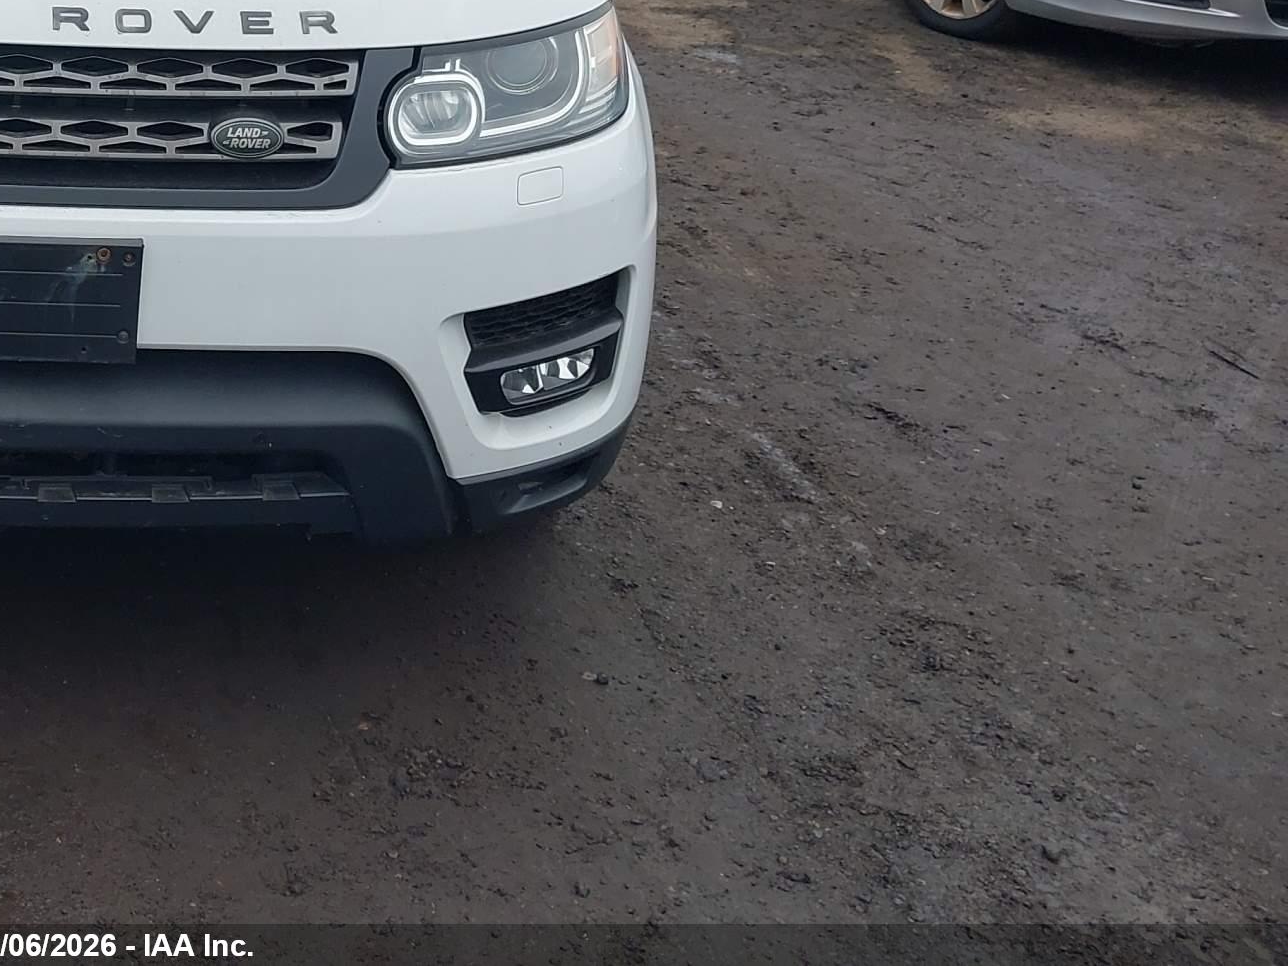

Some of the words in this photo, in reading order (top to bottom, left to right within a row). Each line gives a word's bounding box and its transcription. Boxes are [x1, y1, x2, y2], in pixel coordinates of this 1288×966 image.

[51, 6, 339, 35] ROVER
[226, 127, 262, 138] LAND
[229, 138, 272, 149] ROVER
